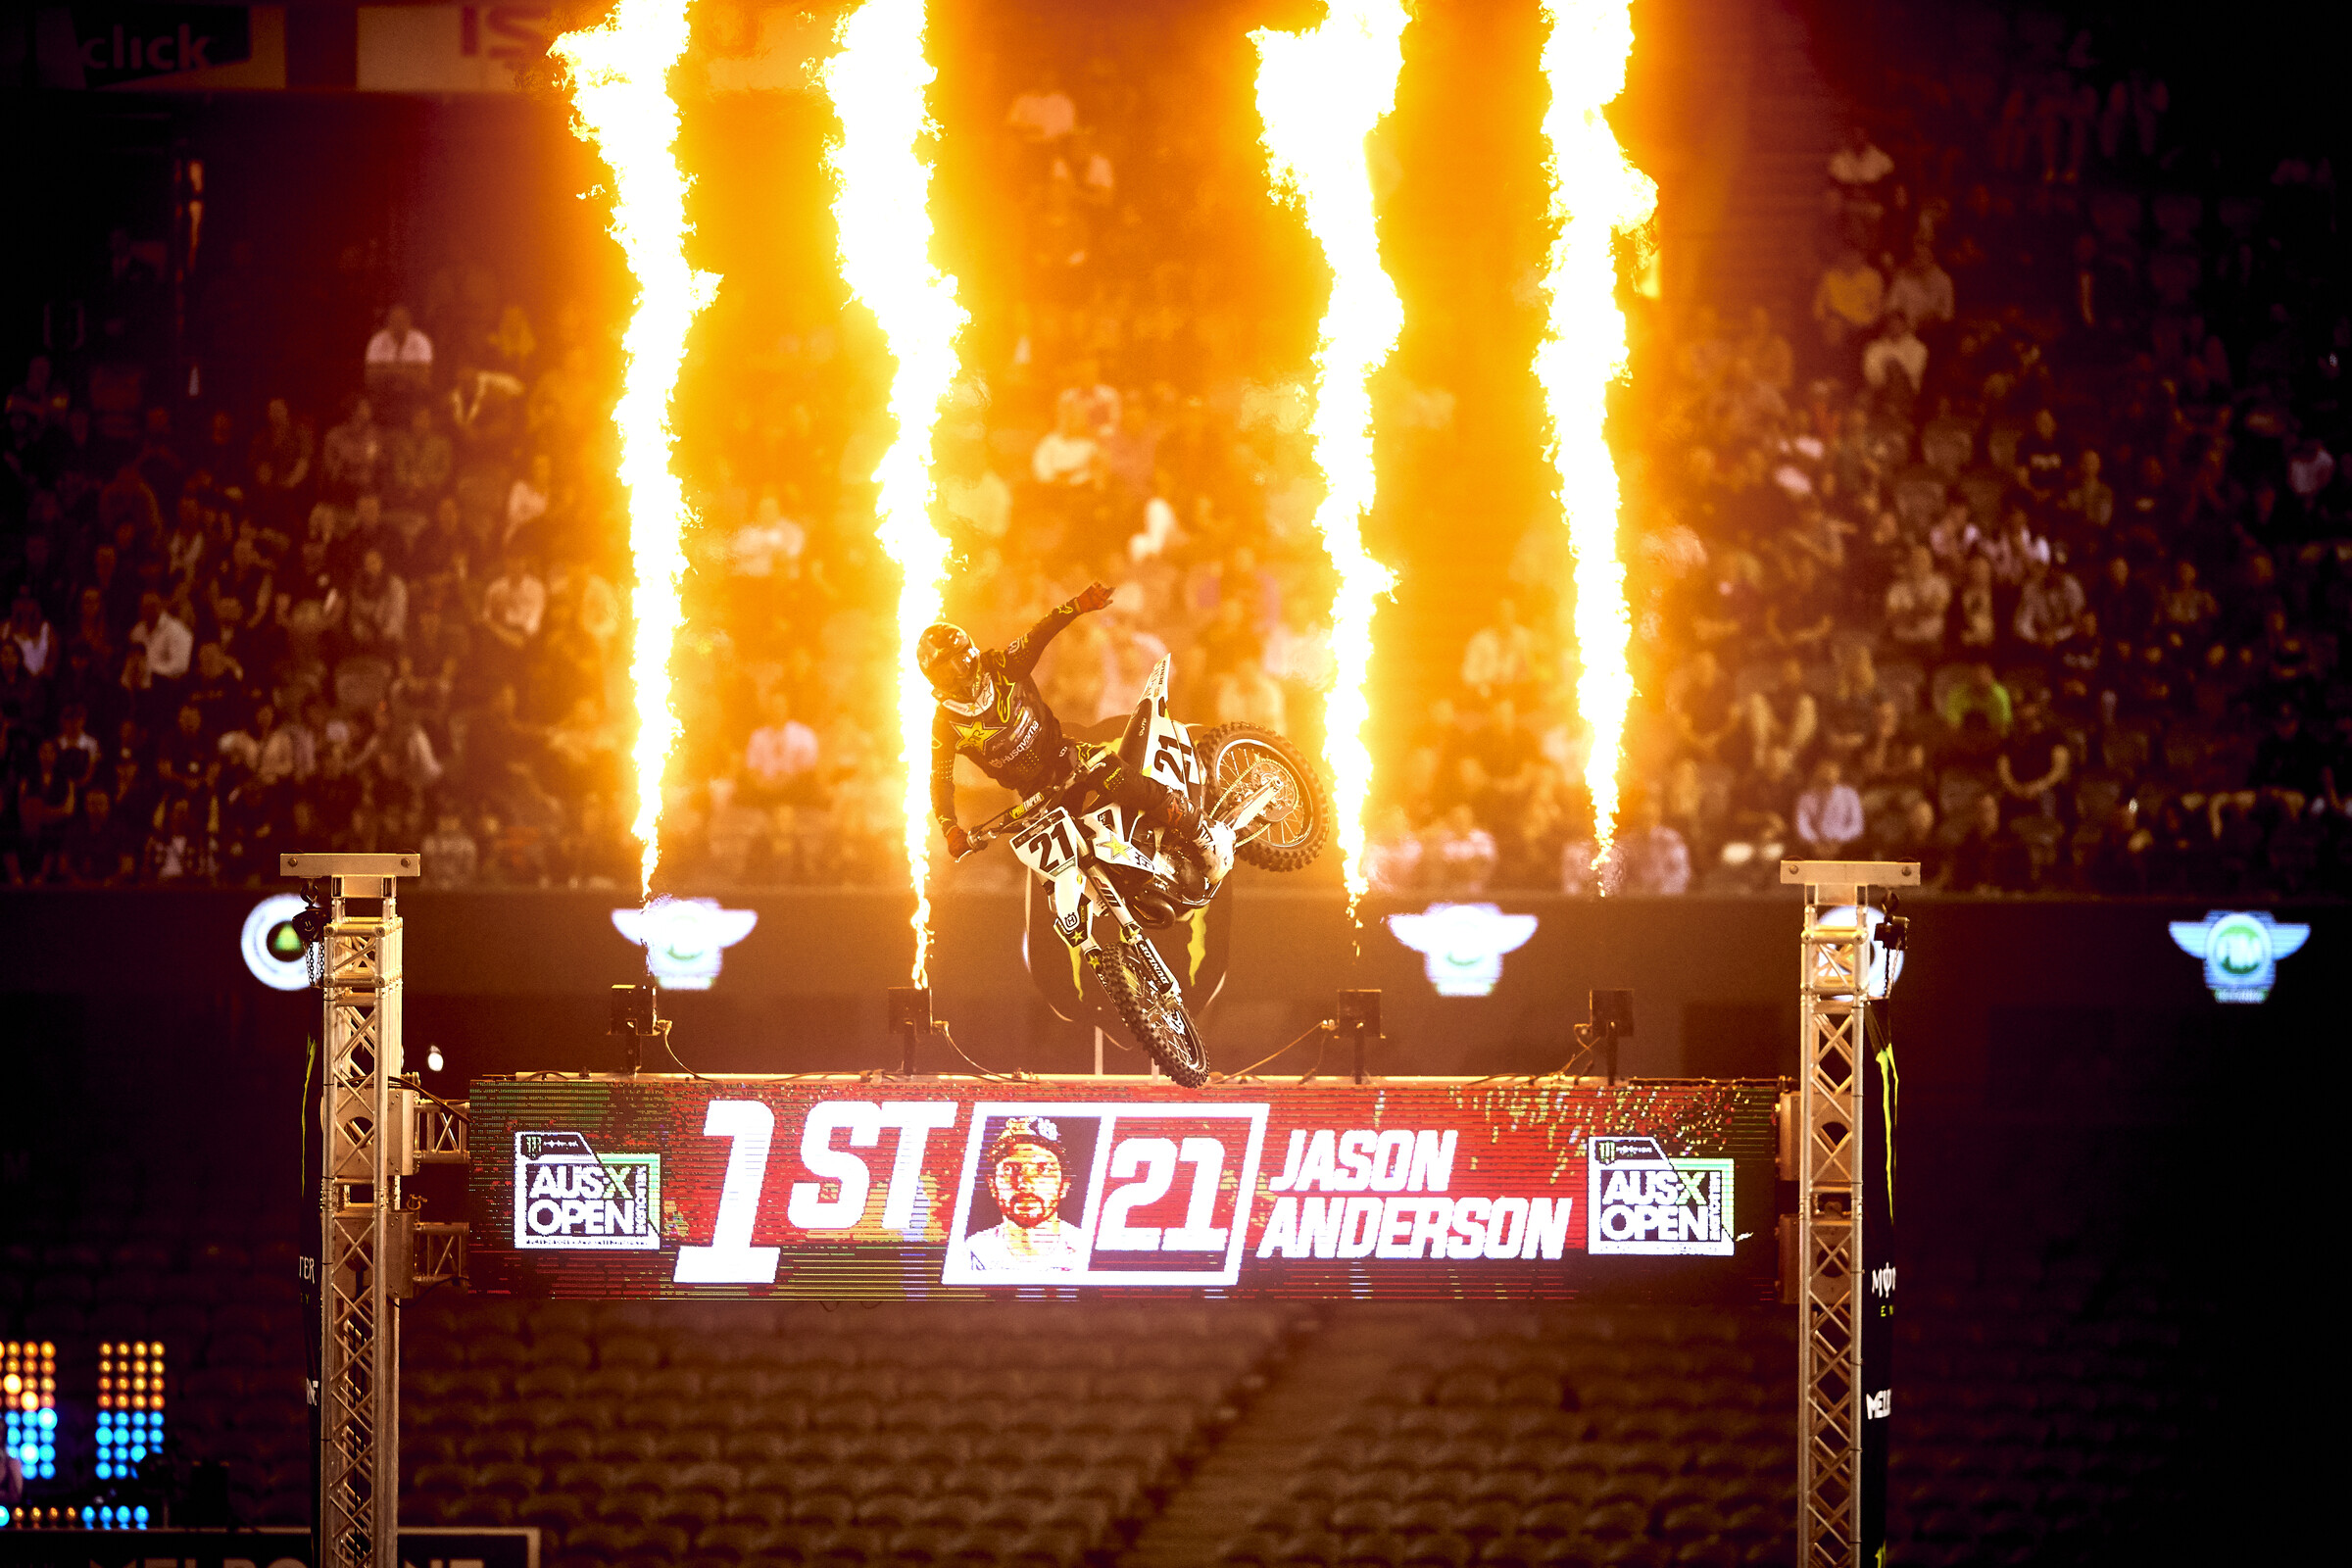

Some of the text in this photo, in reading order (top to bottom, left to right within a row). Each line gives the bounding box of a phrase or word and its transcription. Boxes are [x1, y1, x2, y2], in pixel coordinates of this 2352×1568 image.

[1029, 821, 1074, 873] 21
[1139, 941, 1169, 986] DUNLOP
[1269, 1130, 1458, 1192] JASON
[527, 1199, 635, 1236] OPEN
[673, 1100, 958, 1284] 1ST
[1095, 1137, 1229, 1251] 21
[1256, 1197, 1573, 1261] ANDERSON
[1599, 1204, 1709, 1241] OPEN
